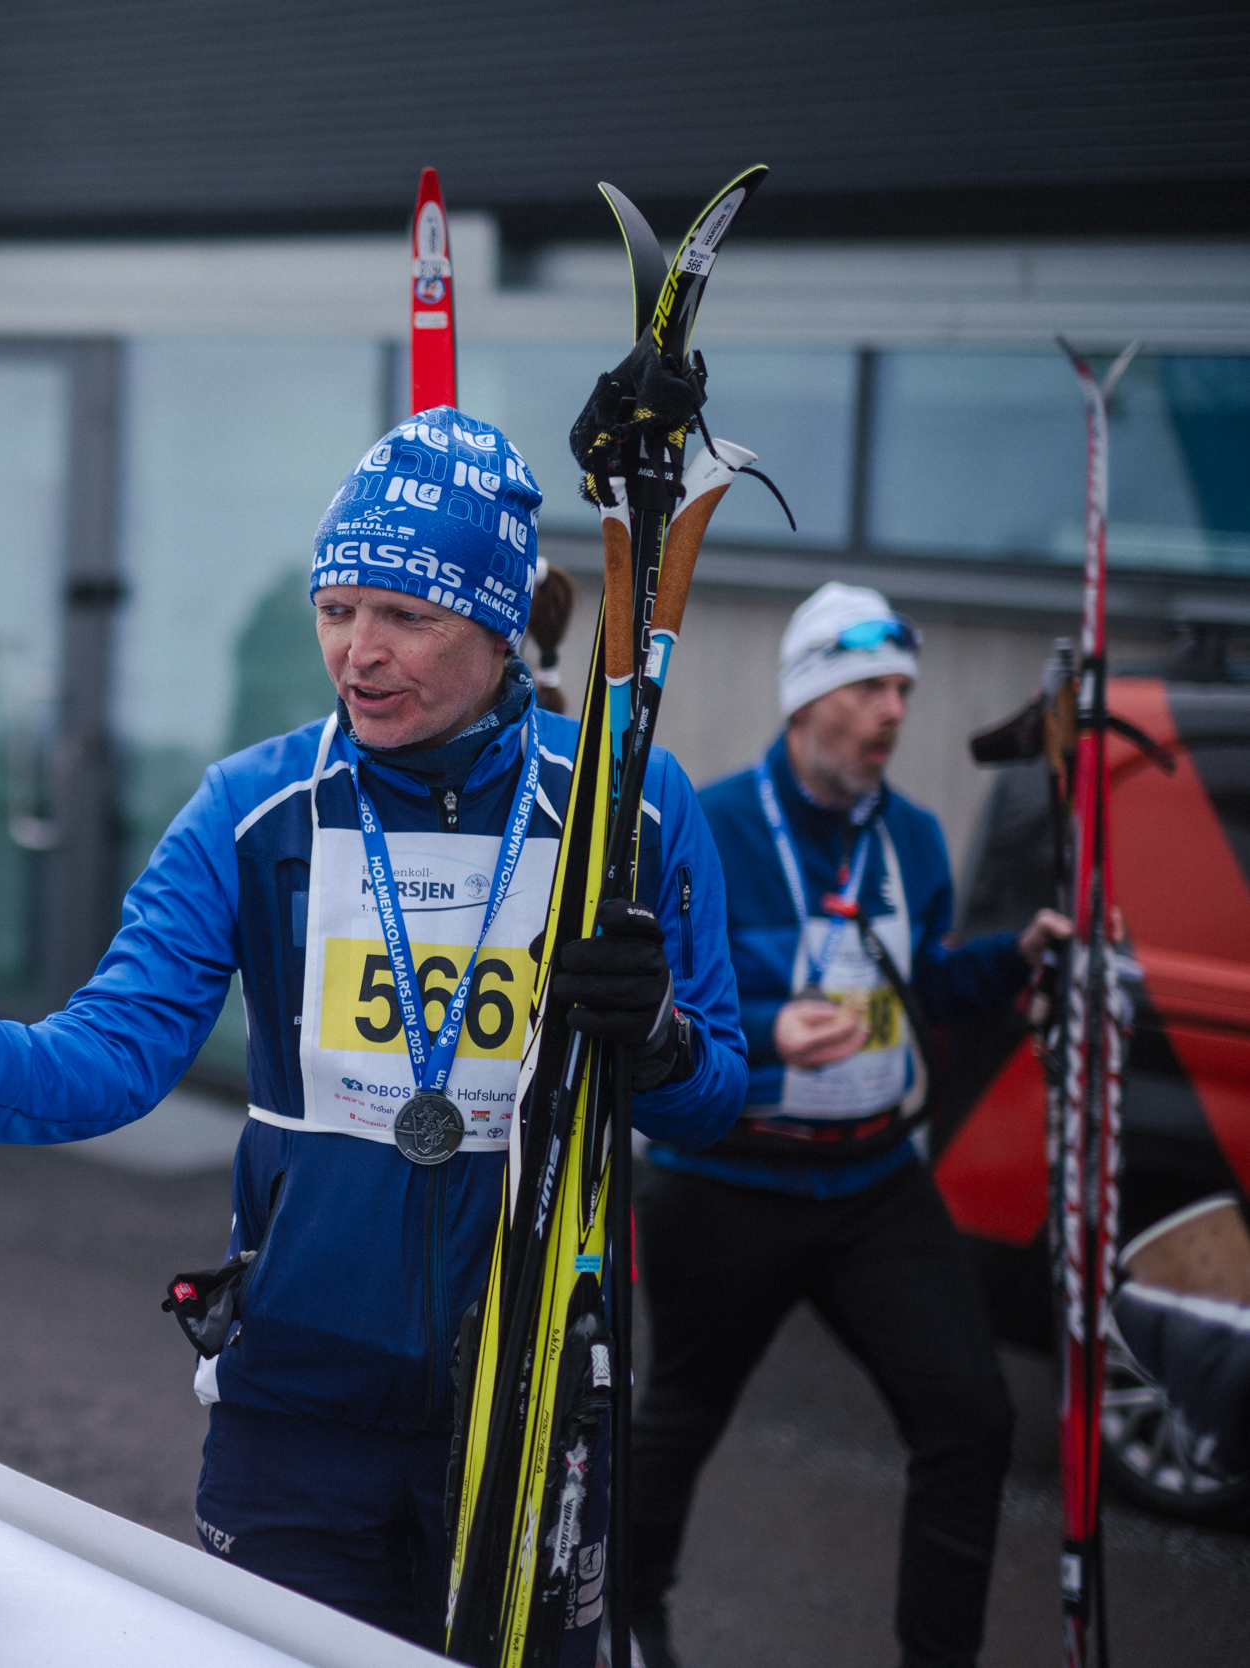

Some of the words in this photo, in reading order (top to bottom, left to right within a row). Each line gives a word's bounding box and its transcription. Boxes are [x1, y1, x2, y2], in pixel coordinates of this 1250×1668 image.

[686, 259, 703, 272] 566
[696, 252, 710, 261] OBOS
[351, 522, 396, 532] BULL
[359, 530, 395, 538] KAJAKK
[475, 587, 521, 623] TRIMTEX
[361, 879, 454, 902] MRSJEN
[430, 1070, 447, 1090] km
[451, 976, 470, 1022] OBOS
[526, 758, 539, 790] 2025
[370, 856, 417, 1027] HOLMENKOLLMARSJEN
[408, 1030, 425, 1064] 2025
[355, 954, 514, 1050] 566
[367, 1084, 411, 1099] OBOS
[535, 1134, 560, 1240] SWIX
[537, 1409, 549, 1464] FISCHER
